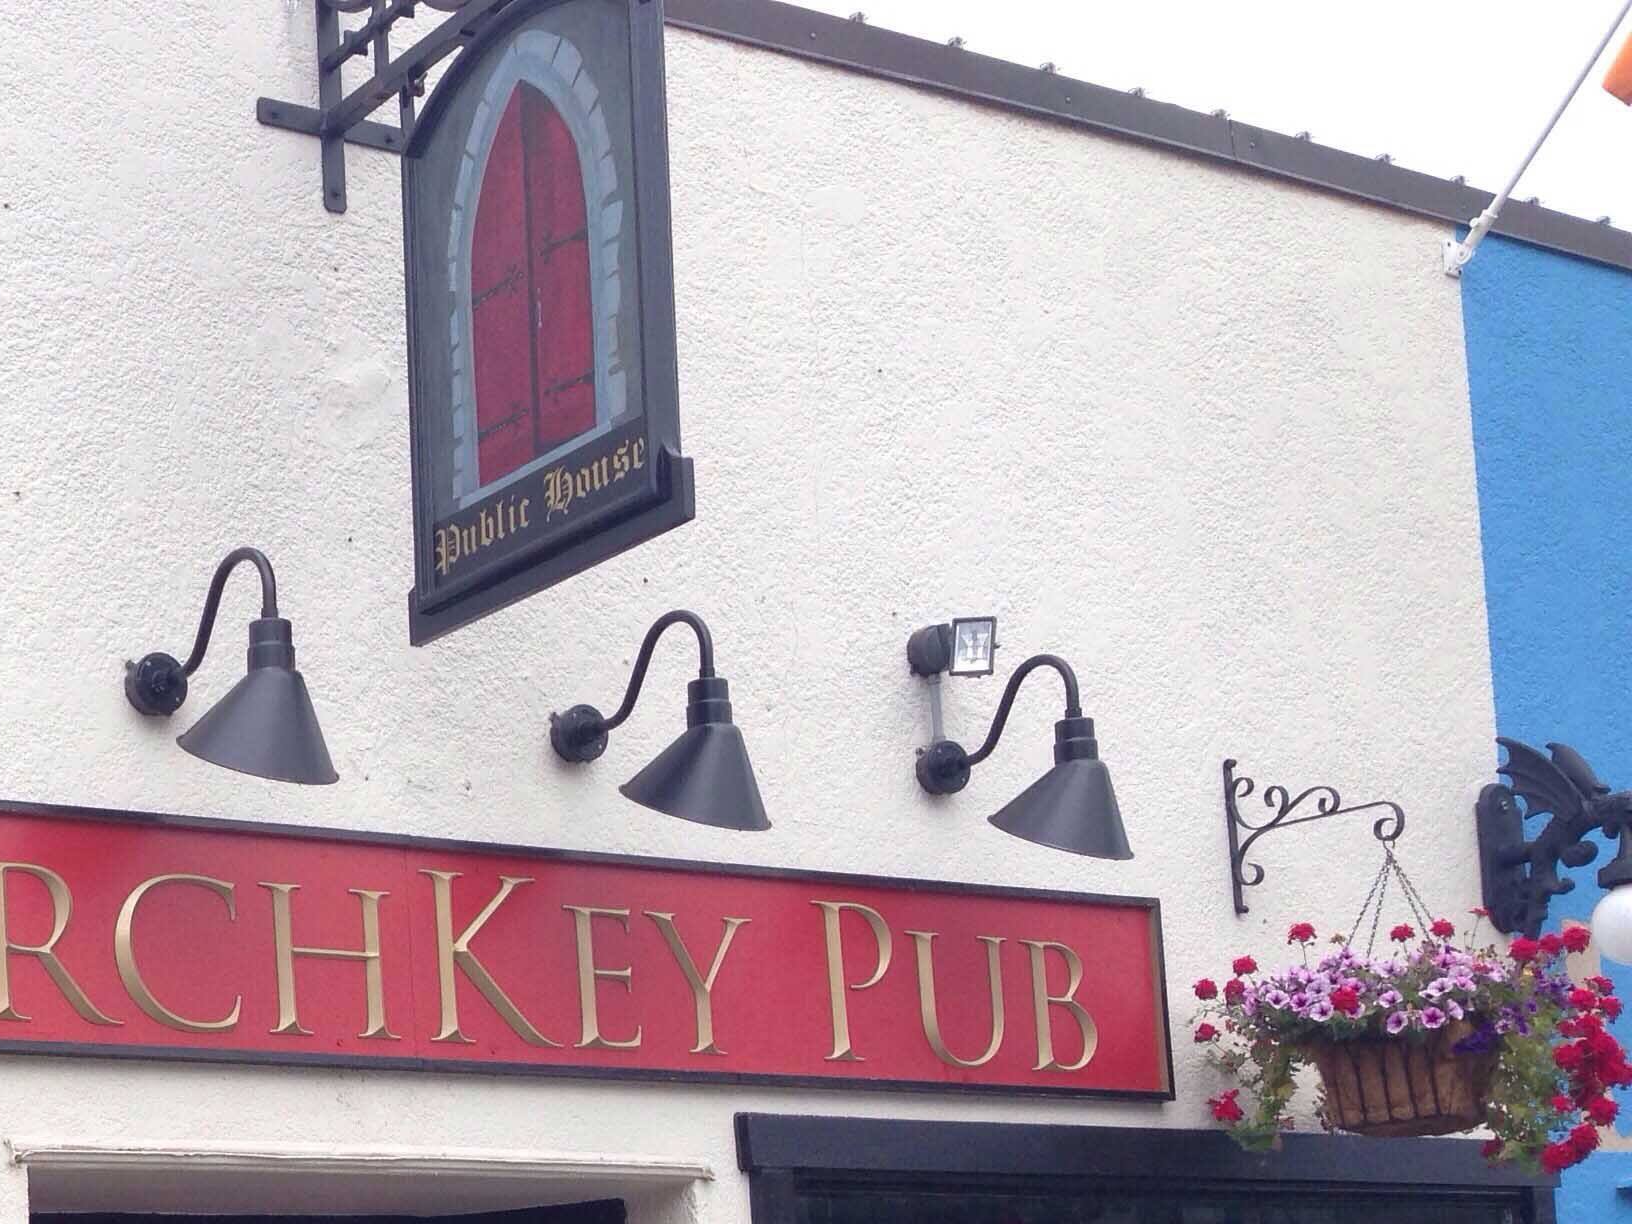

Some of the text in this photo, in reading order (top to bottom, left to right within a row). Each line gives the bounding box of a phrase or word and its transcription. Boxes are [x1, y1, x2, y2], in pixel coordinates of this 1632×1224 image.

[434, 437, 646, 575] Public House
[809, 900, 1099, 1074] PUB
